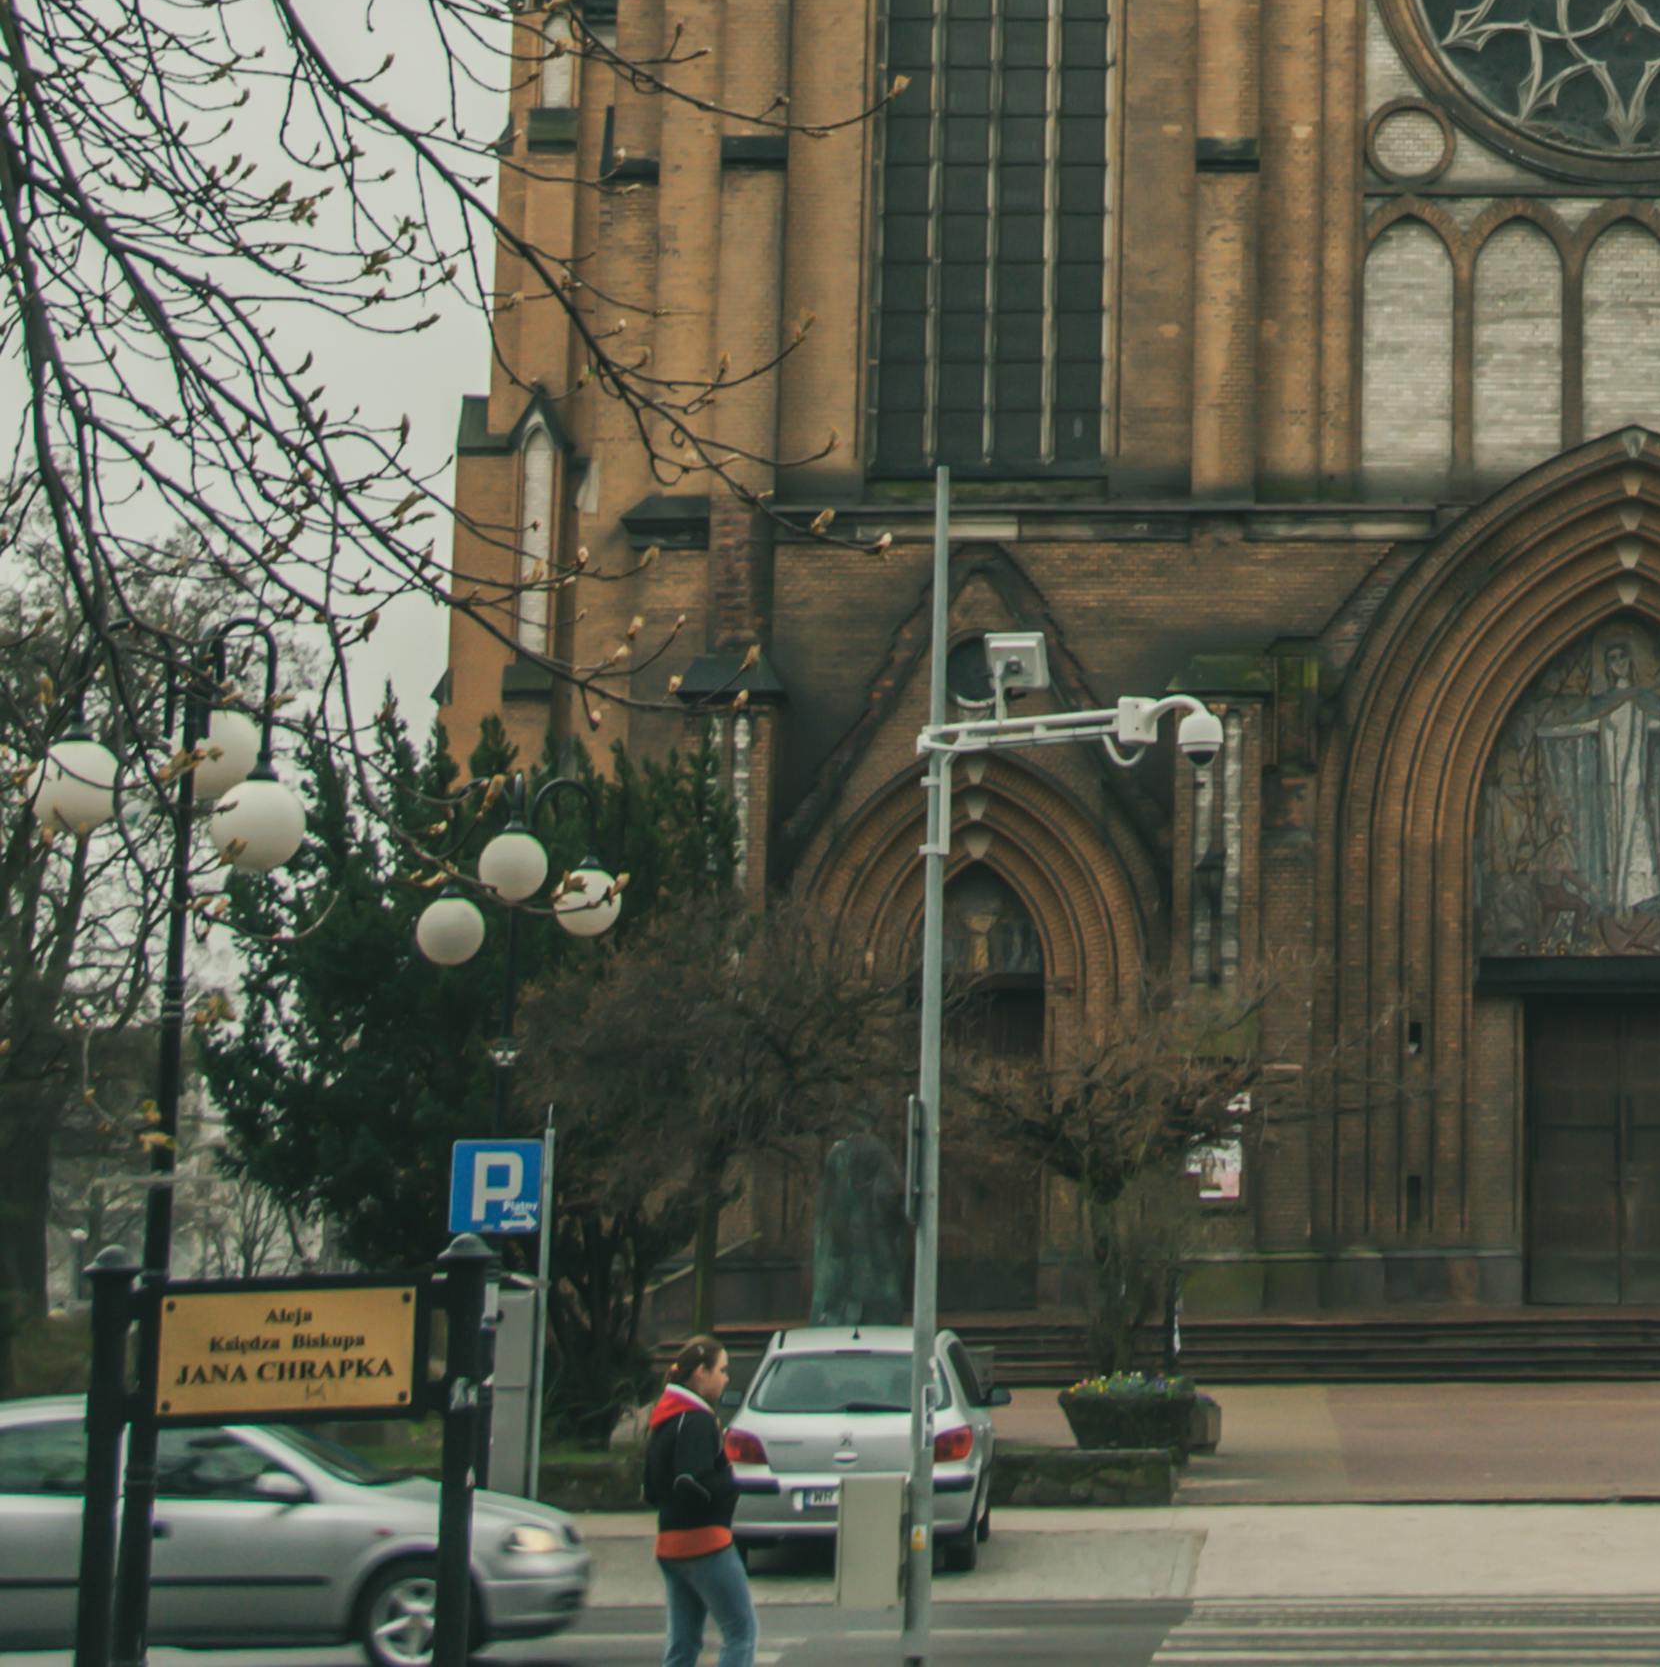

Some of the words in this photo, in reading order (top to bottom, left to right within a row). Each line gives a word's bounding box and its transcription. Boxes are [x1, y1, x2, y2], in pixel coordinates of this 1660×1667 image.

[471, 1152, 523, 1221] P
[265, 1307, 313, 1326] Aleja
[209, 1335, 280, 1355] Księdza
[292, 1332, 365, 1352] Biskupa
[176, 1364, 248, 1385] JANA
[256, 1358, 394, 1381] CHRAPKA
